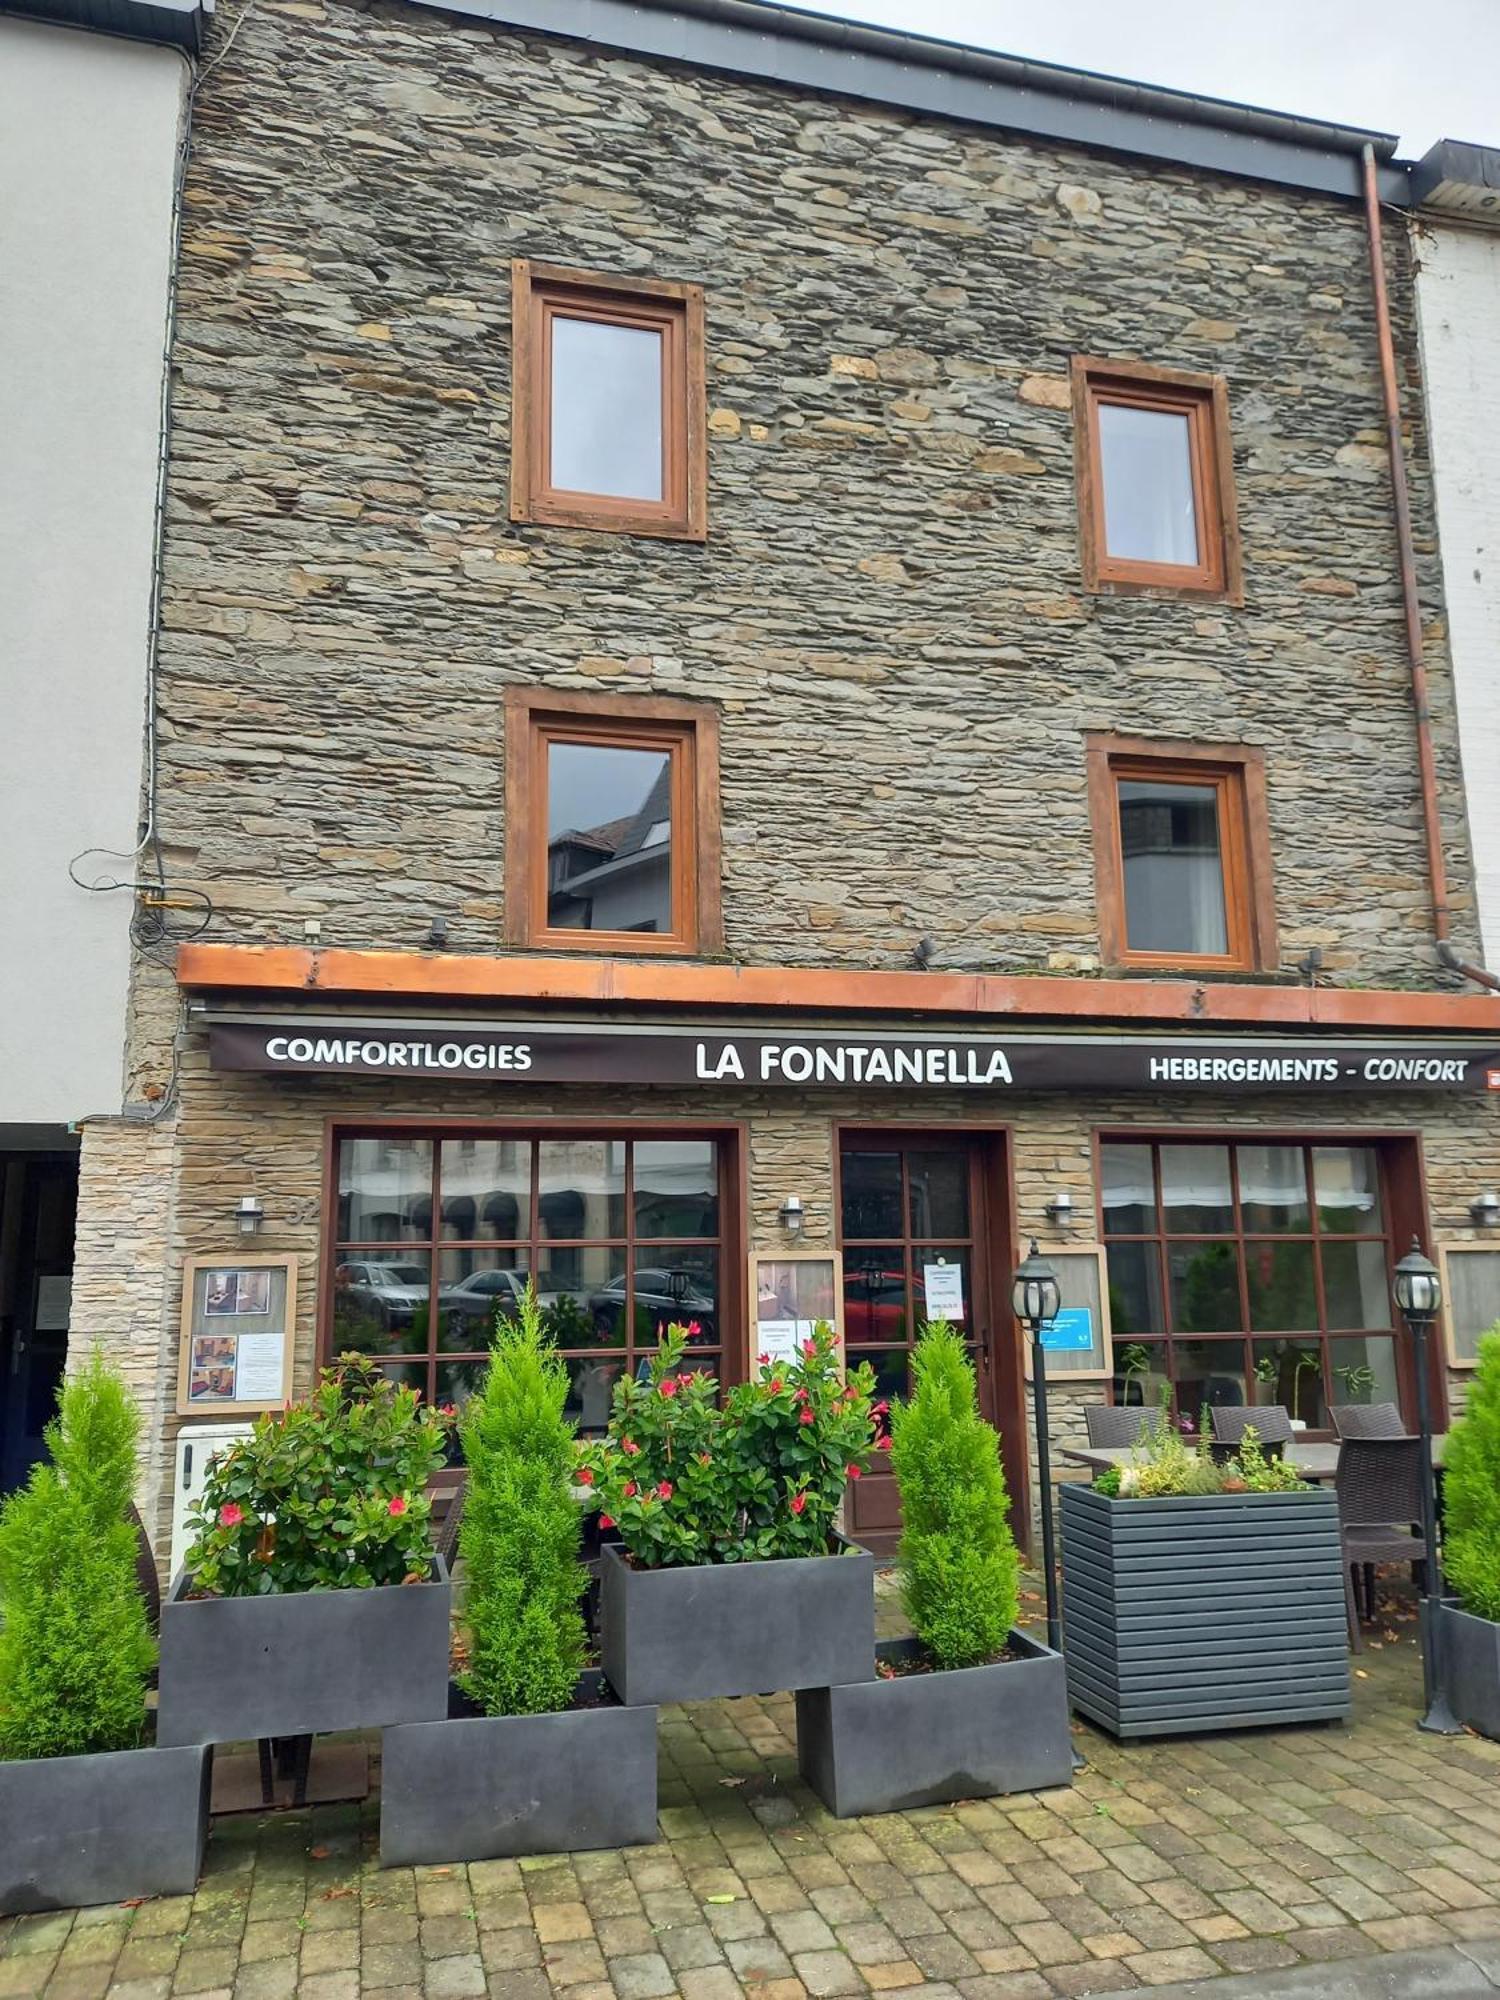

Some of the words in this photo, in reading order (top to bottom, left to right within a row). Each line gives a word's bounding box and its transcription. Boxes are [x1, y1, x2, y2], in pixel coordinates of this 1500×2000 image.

[266, 1037, 532, 1070] COMFORTLOGIES
[696, 1044, 745, 1080] LA
[760, 1046, 1013, 1084] FONTANELLA
[1150, 1058, 1339, 1081] HEBERGEMENTS
[1363, 1058, 1469, 1081] CONFORT
